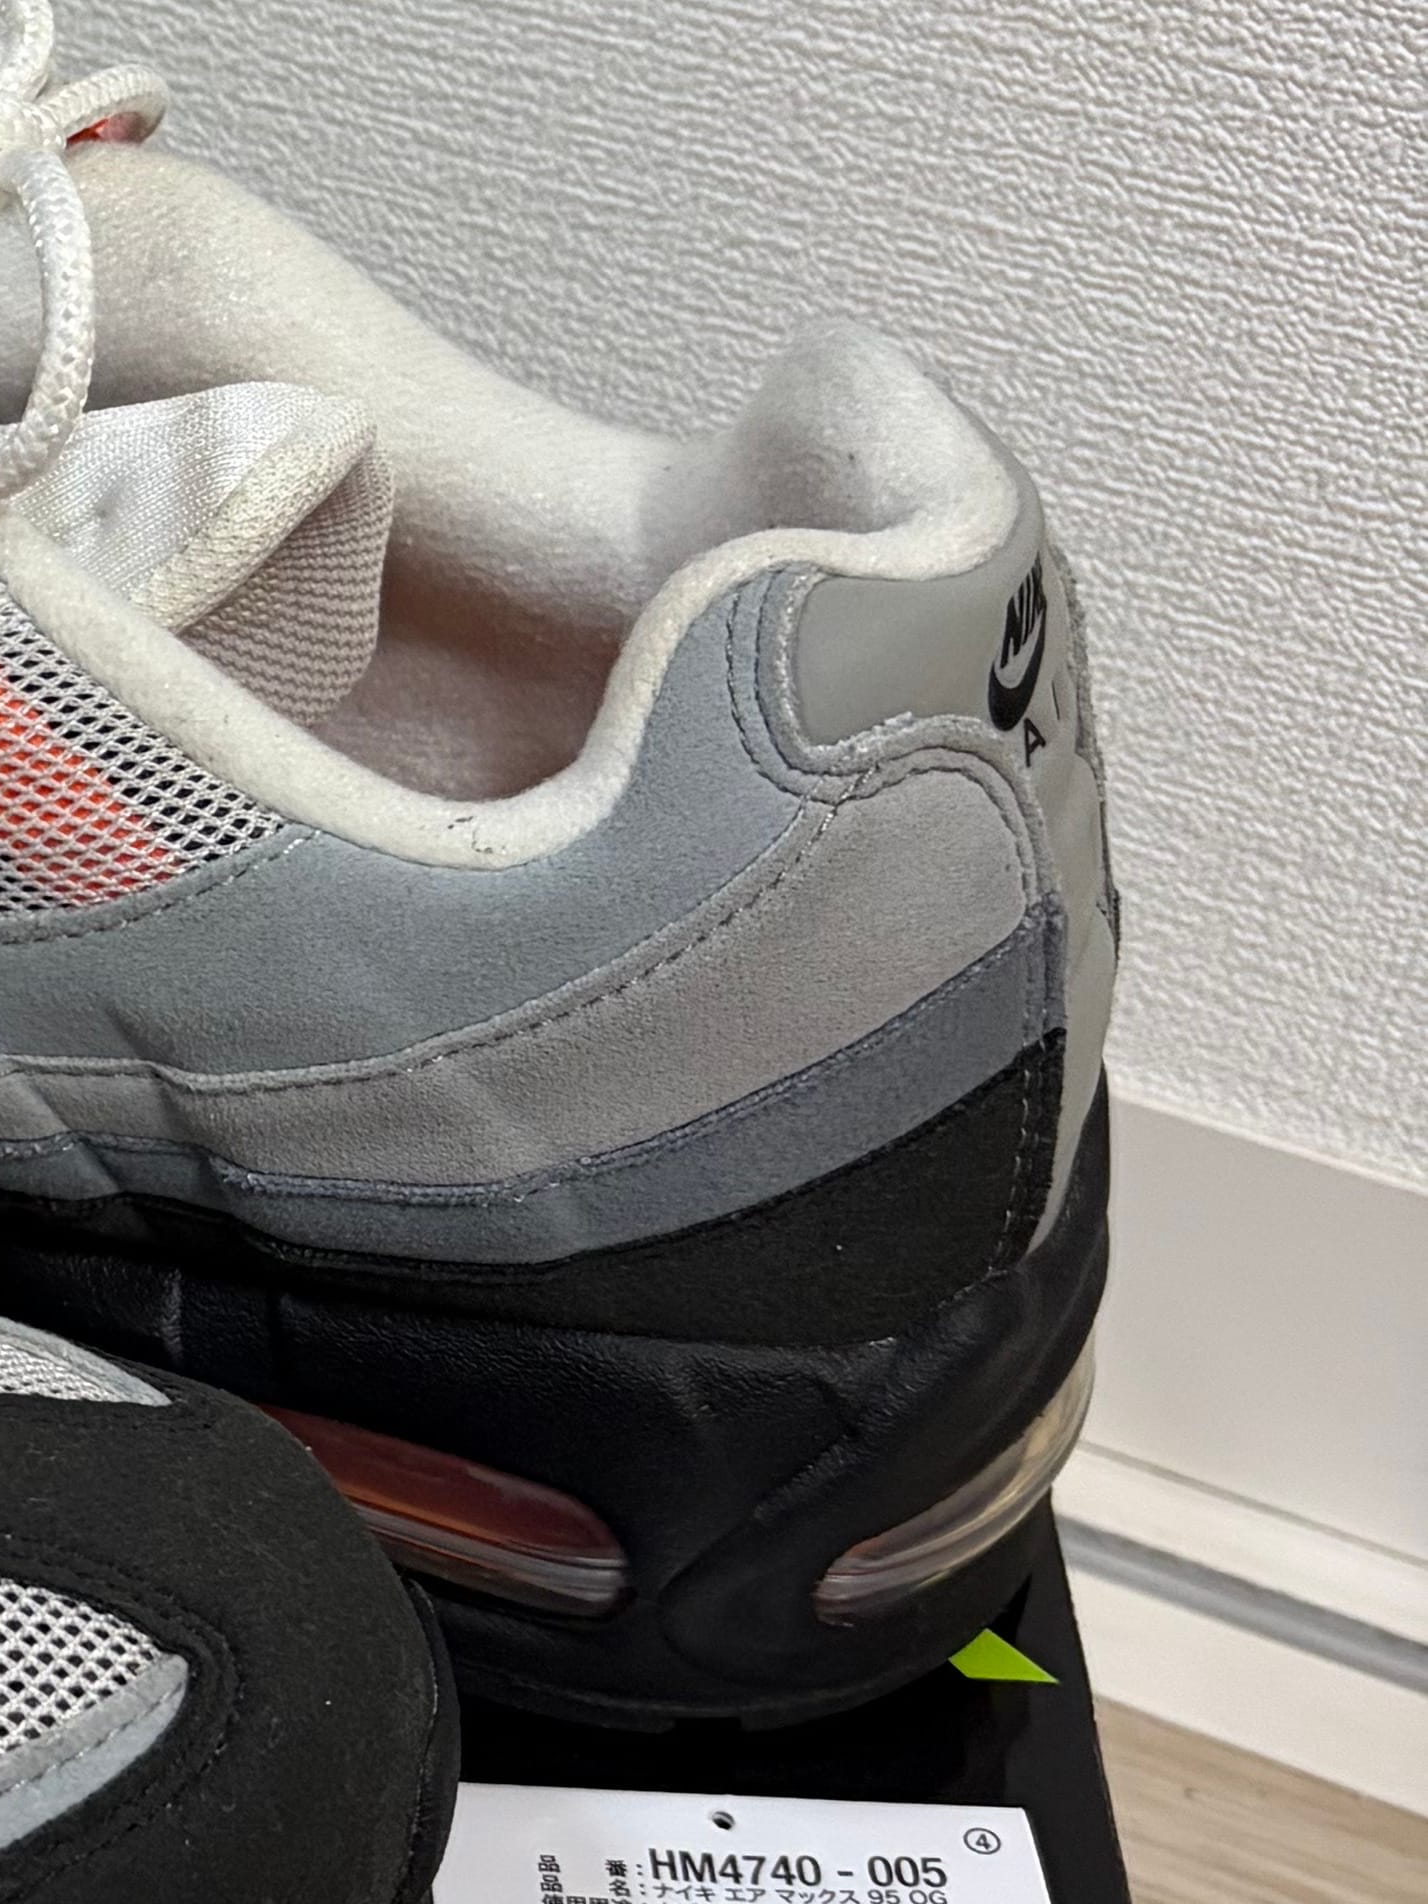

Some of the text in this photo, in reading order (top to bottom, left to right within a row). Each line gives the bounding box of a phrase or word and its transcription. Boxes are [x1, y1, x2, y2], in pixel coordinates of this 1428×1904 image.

[648, 1848, 822, 1886] HM4740
[867, 1855, 948, 1888] 005
[652, 1884, 716, 1902] ナイキ
[724, 1887, 766, 1902] エア
[775, 1889, 860, 1904] マックス
